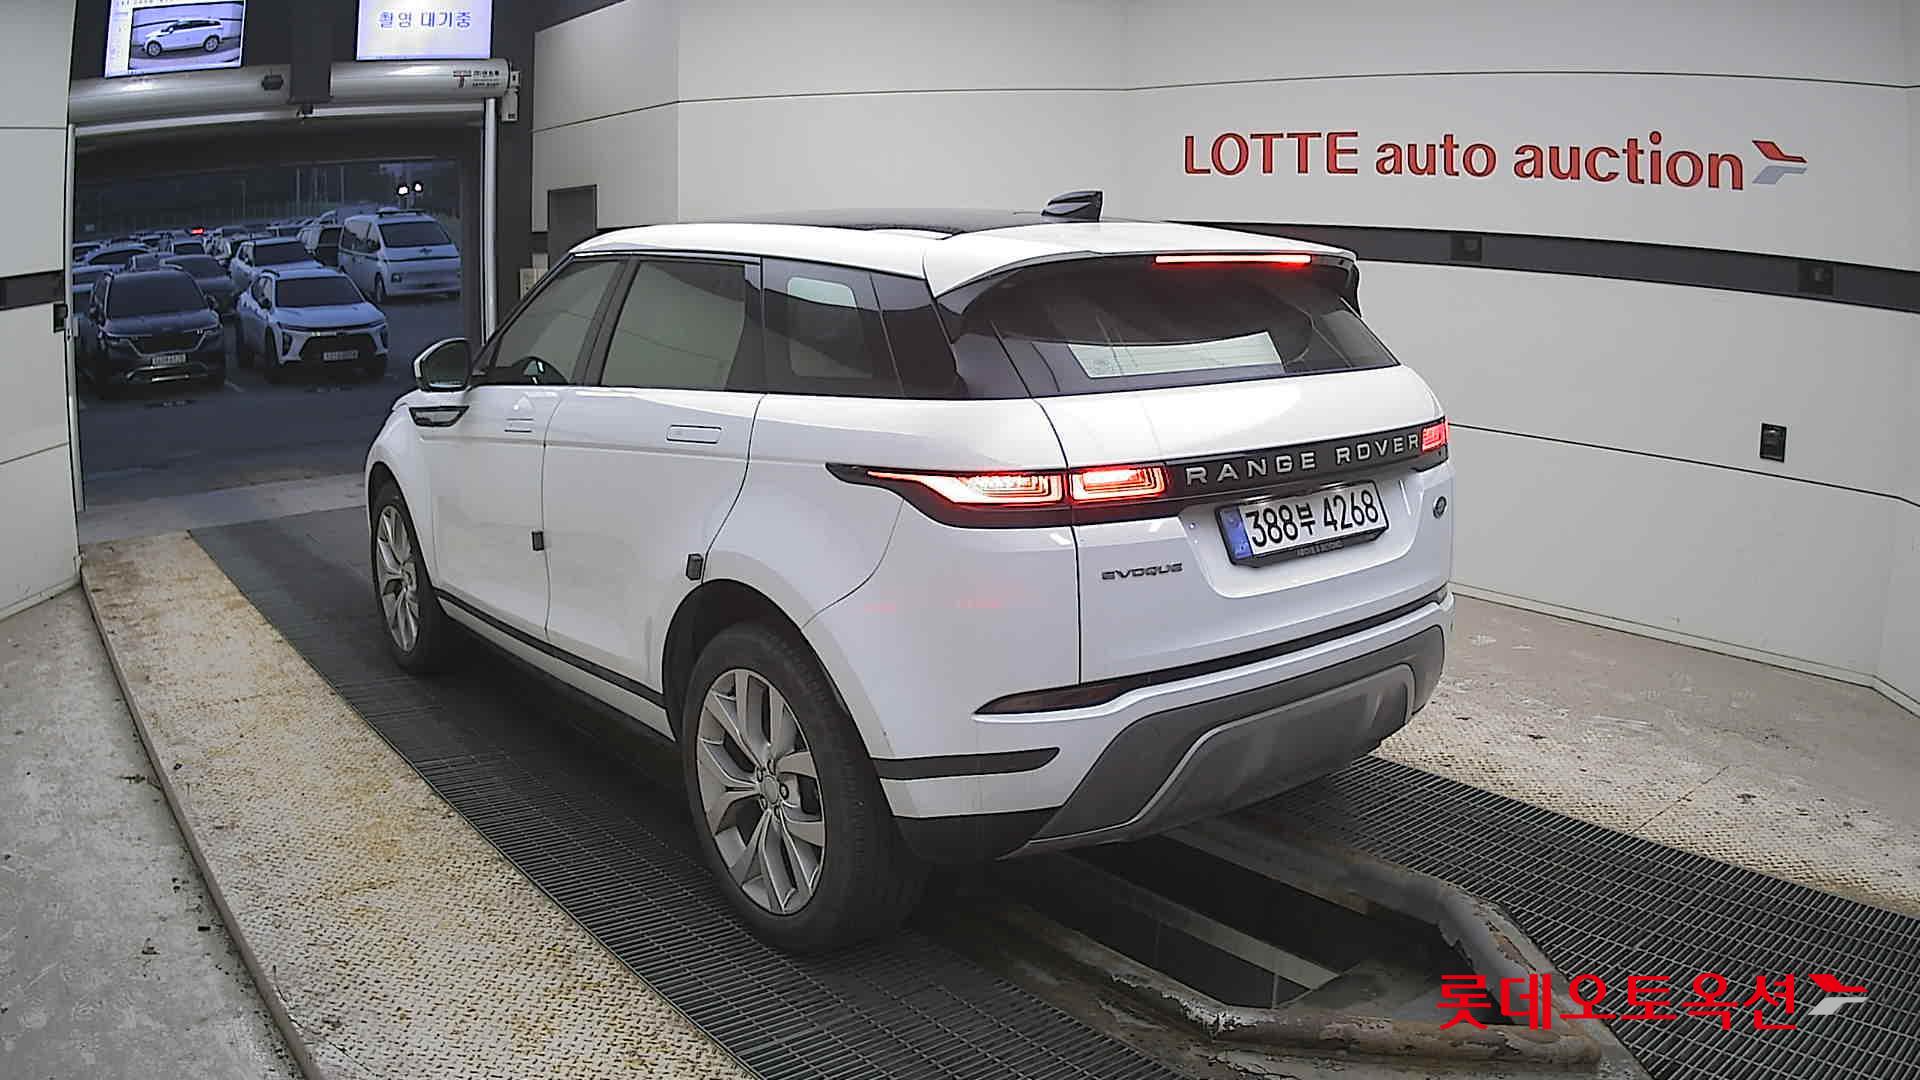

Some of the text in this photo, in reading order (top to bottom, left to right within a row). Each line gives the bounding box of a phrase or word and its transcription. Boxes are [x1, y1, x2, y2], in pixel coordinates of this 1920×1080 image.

[420, 12, 471, 28] 대기중
[1184, 130, 1744, 191] LOTTE auto auction
[1186, 433, 1420, 486] RANGE ROVER
[1246, 489, 1379, 547] 388부 4268
[1101, 562, 1183, 580] EVOQUE
